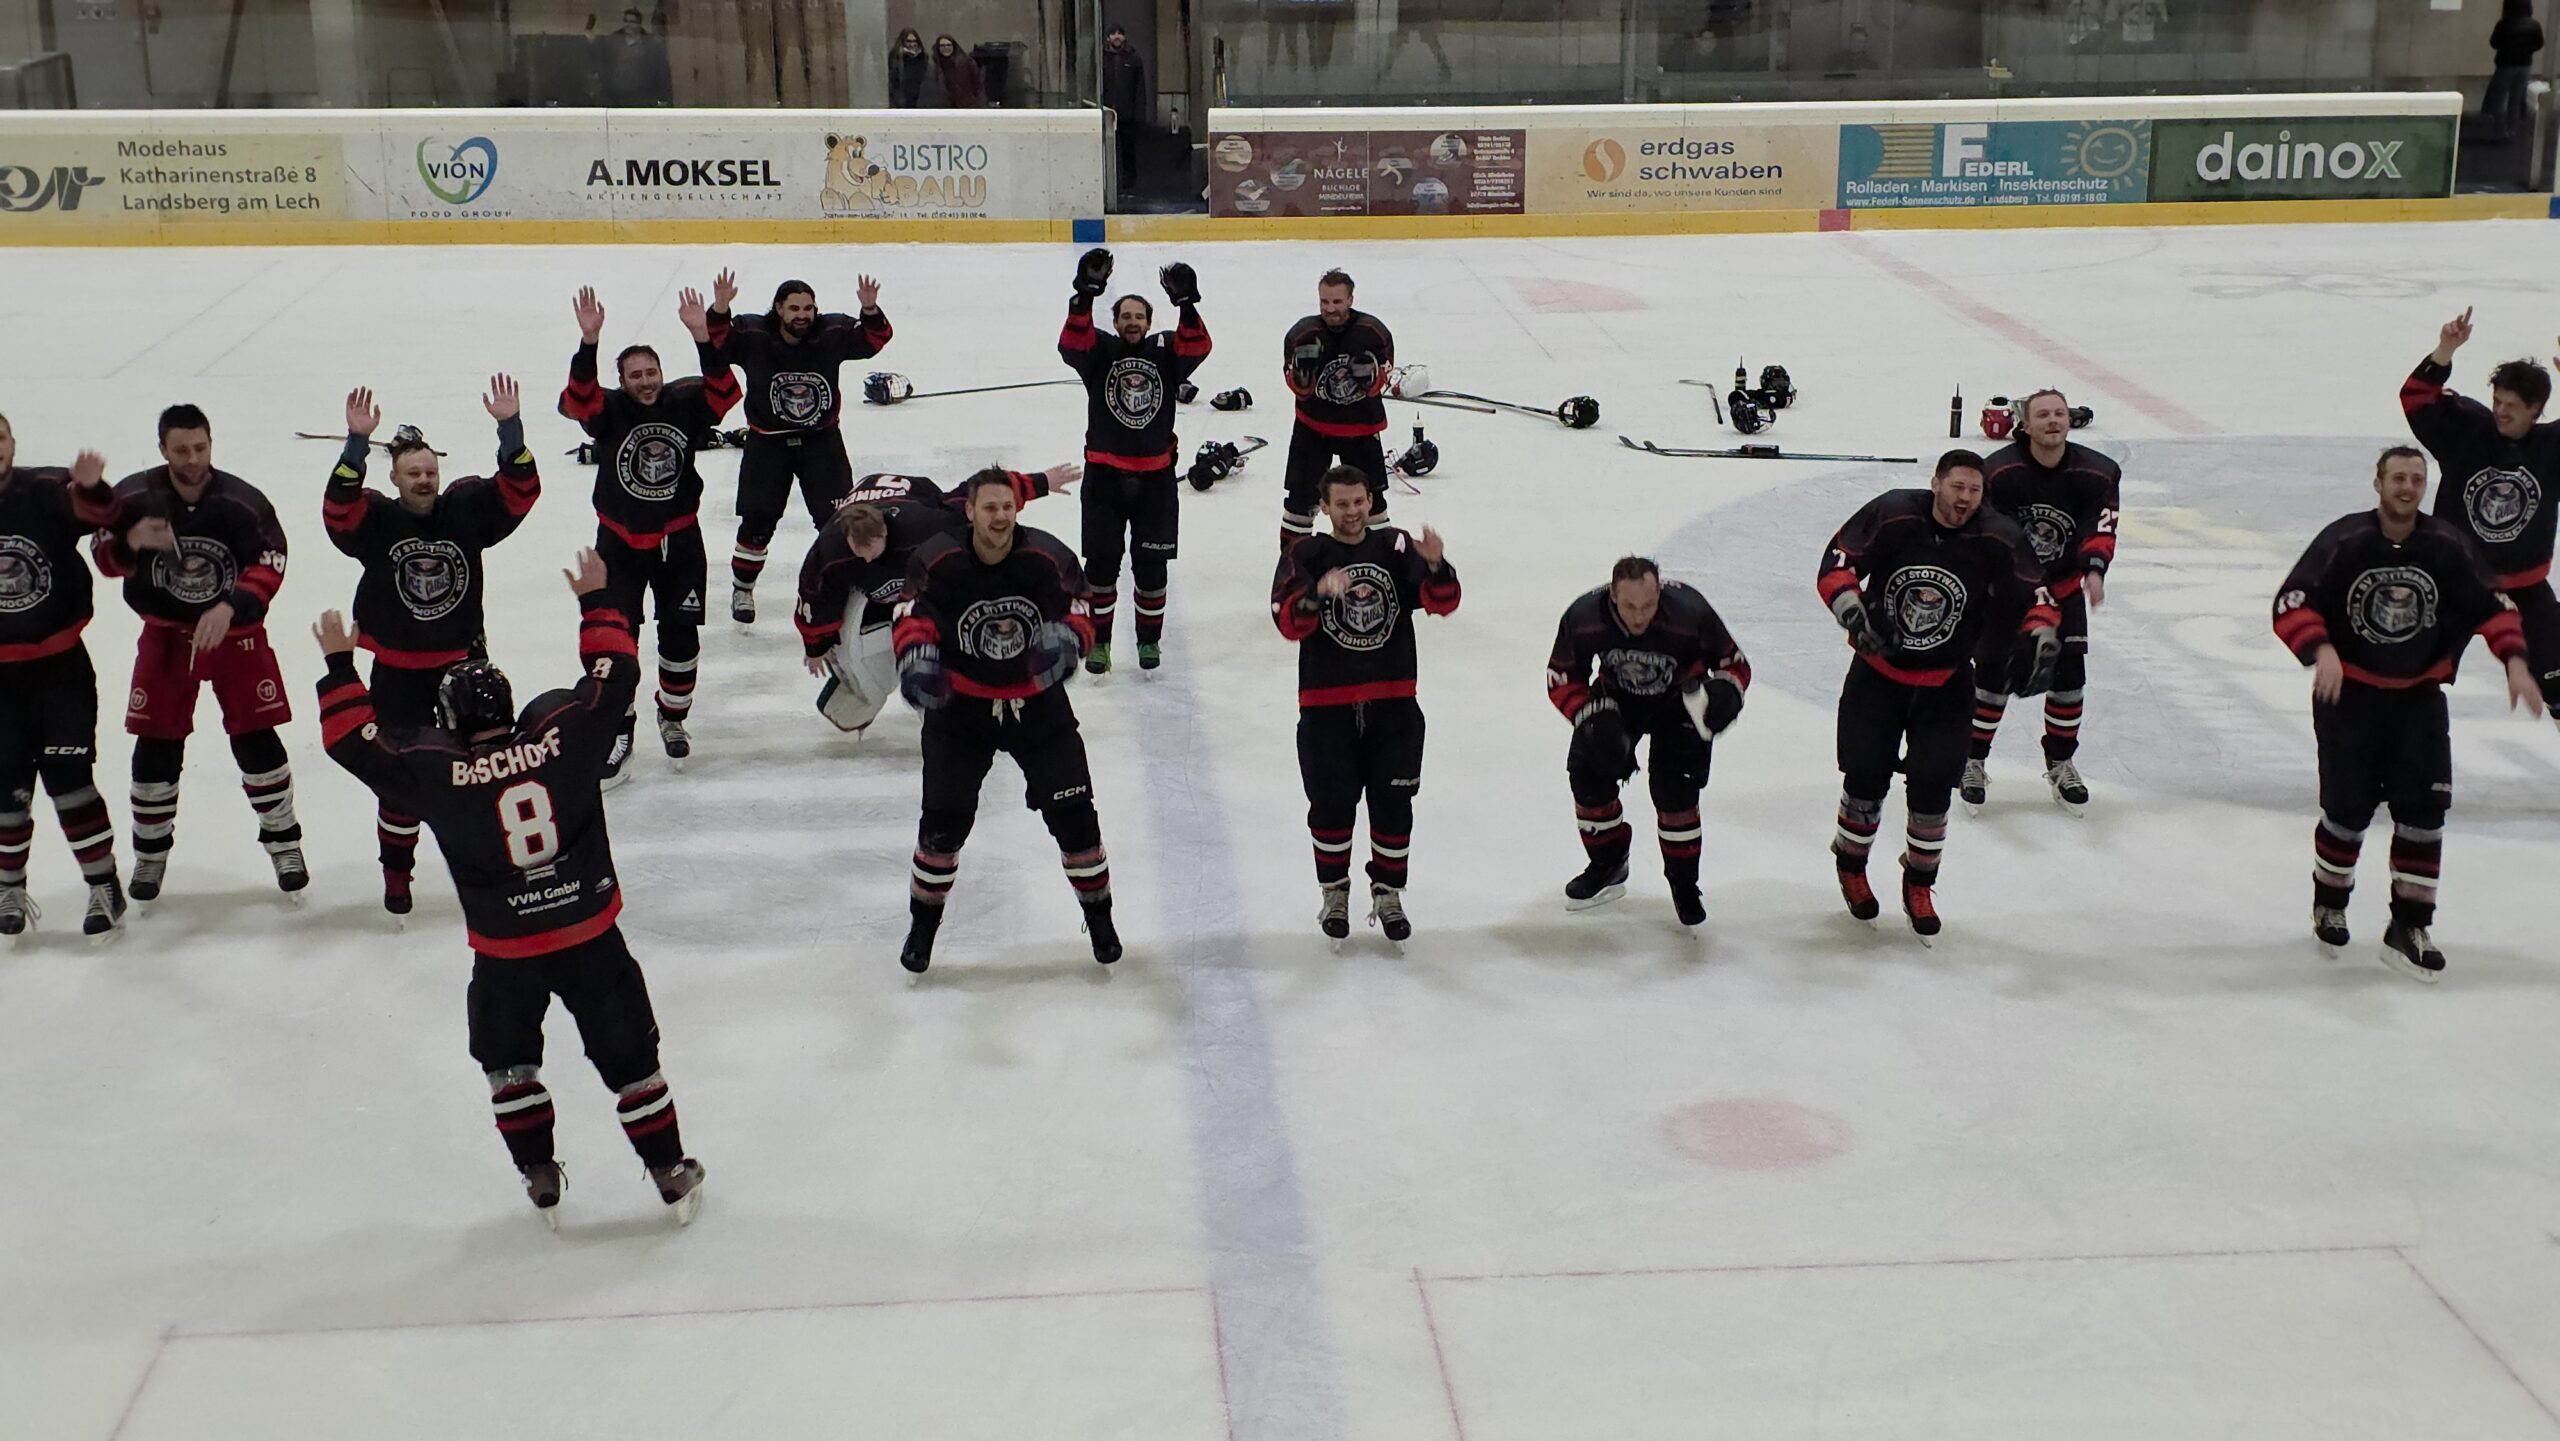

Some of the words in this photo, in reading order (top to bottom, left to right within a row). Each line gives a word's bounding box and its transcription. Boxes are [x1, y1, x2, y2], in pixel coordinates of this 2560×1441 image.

[117, 140, 227, 157] Modehaus
[893, 144, 988, 171] BISTRO
[1640, 137, 1735, 160] erdgas
[1942, 123, 2034, 177] FEDERL
[2195, 130, 2404, 181] dainox
[120, 166, 299, 184] Katharinenstraße
[305, 167, 317, 183] 8
[427, 162, 485, 179] VION
[586, 159, 781, 186] A.MOKSEL
[1313, 165, 1369, 179] NÄGELE
[1639, 161, 1783, 180] schwaben
[894, 175, 987, 208] BALU
[1586, 189, 1605, 199] Wir
[1608, 188, 1632, 198] sind
[1654, 190, 1671, 198] wo
[1674, 189, 1712, 198] unsere
[1714, 187, 1757, 197] Kunden
[1759, 186, 1782, 196] sind
[1846, 180, 1909, 194] Rolladen
[1921, 179, 1988, 193] Markisen
[2000, 177, 2108, 191] Insektenschutz
[123, 193, 230, 214] Landsberg
[237, 196, 270, 210] am
[276, 193, 320, 210] Lech
[1894, 573, 1907, 586] SV
[1908, 569, 1963, 600] STÖTTWANG
[43, 745, 89, 755] CCM
[452, 726, 562, 787] BISCHOFF
[1053, 784, 1087, 801] CCM
[496, 779, 559, 870] 8
[507, 890, 542, 907] VVM
[543, 880, 581, 900] GmbH
